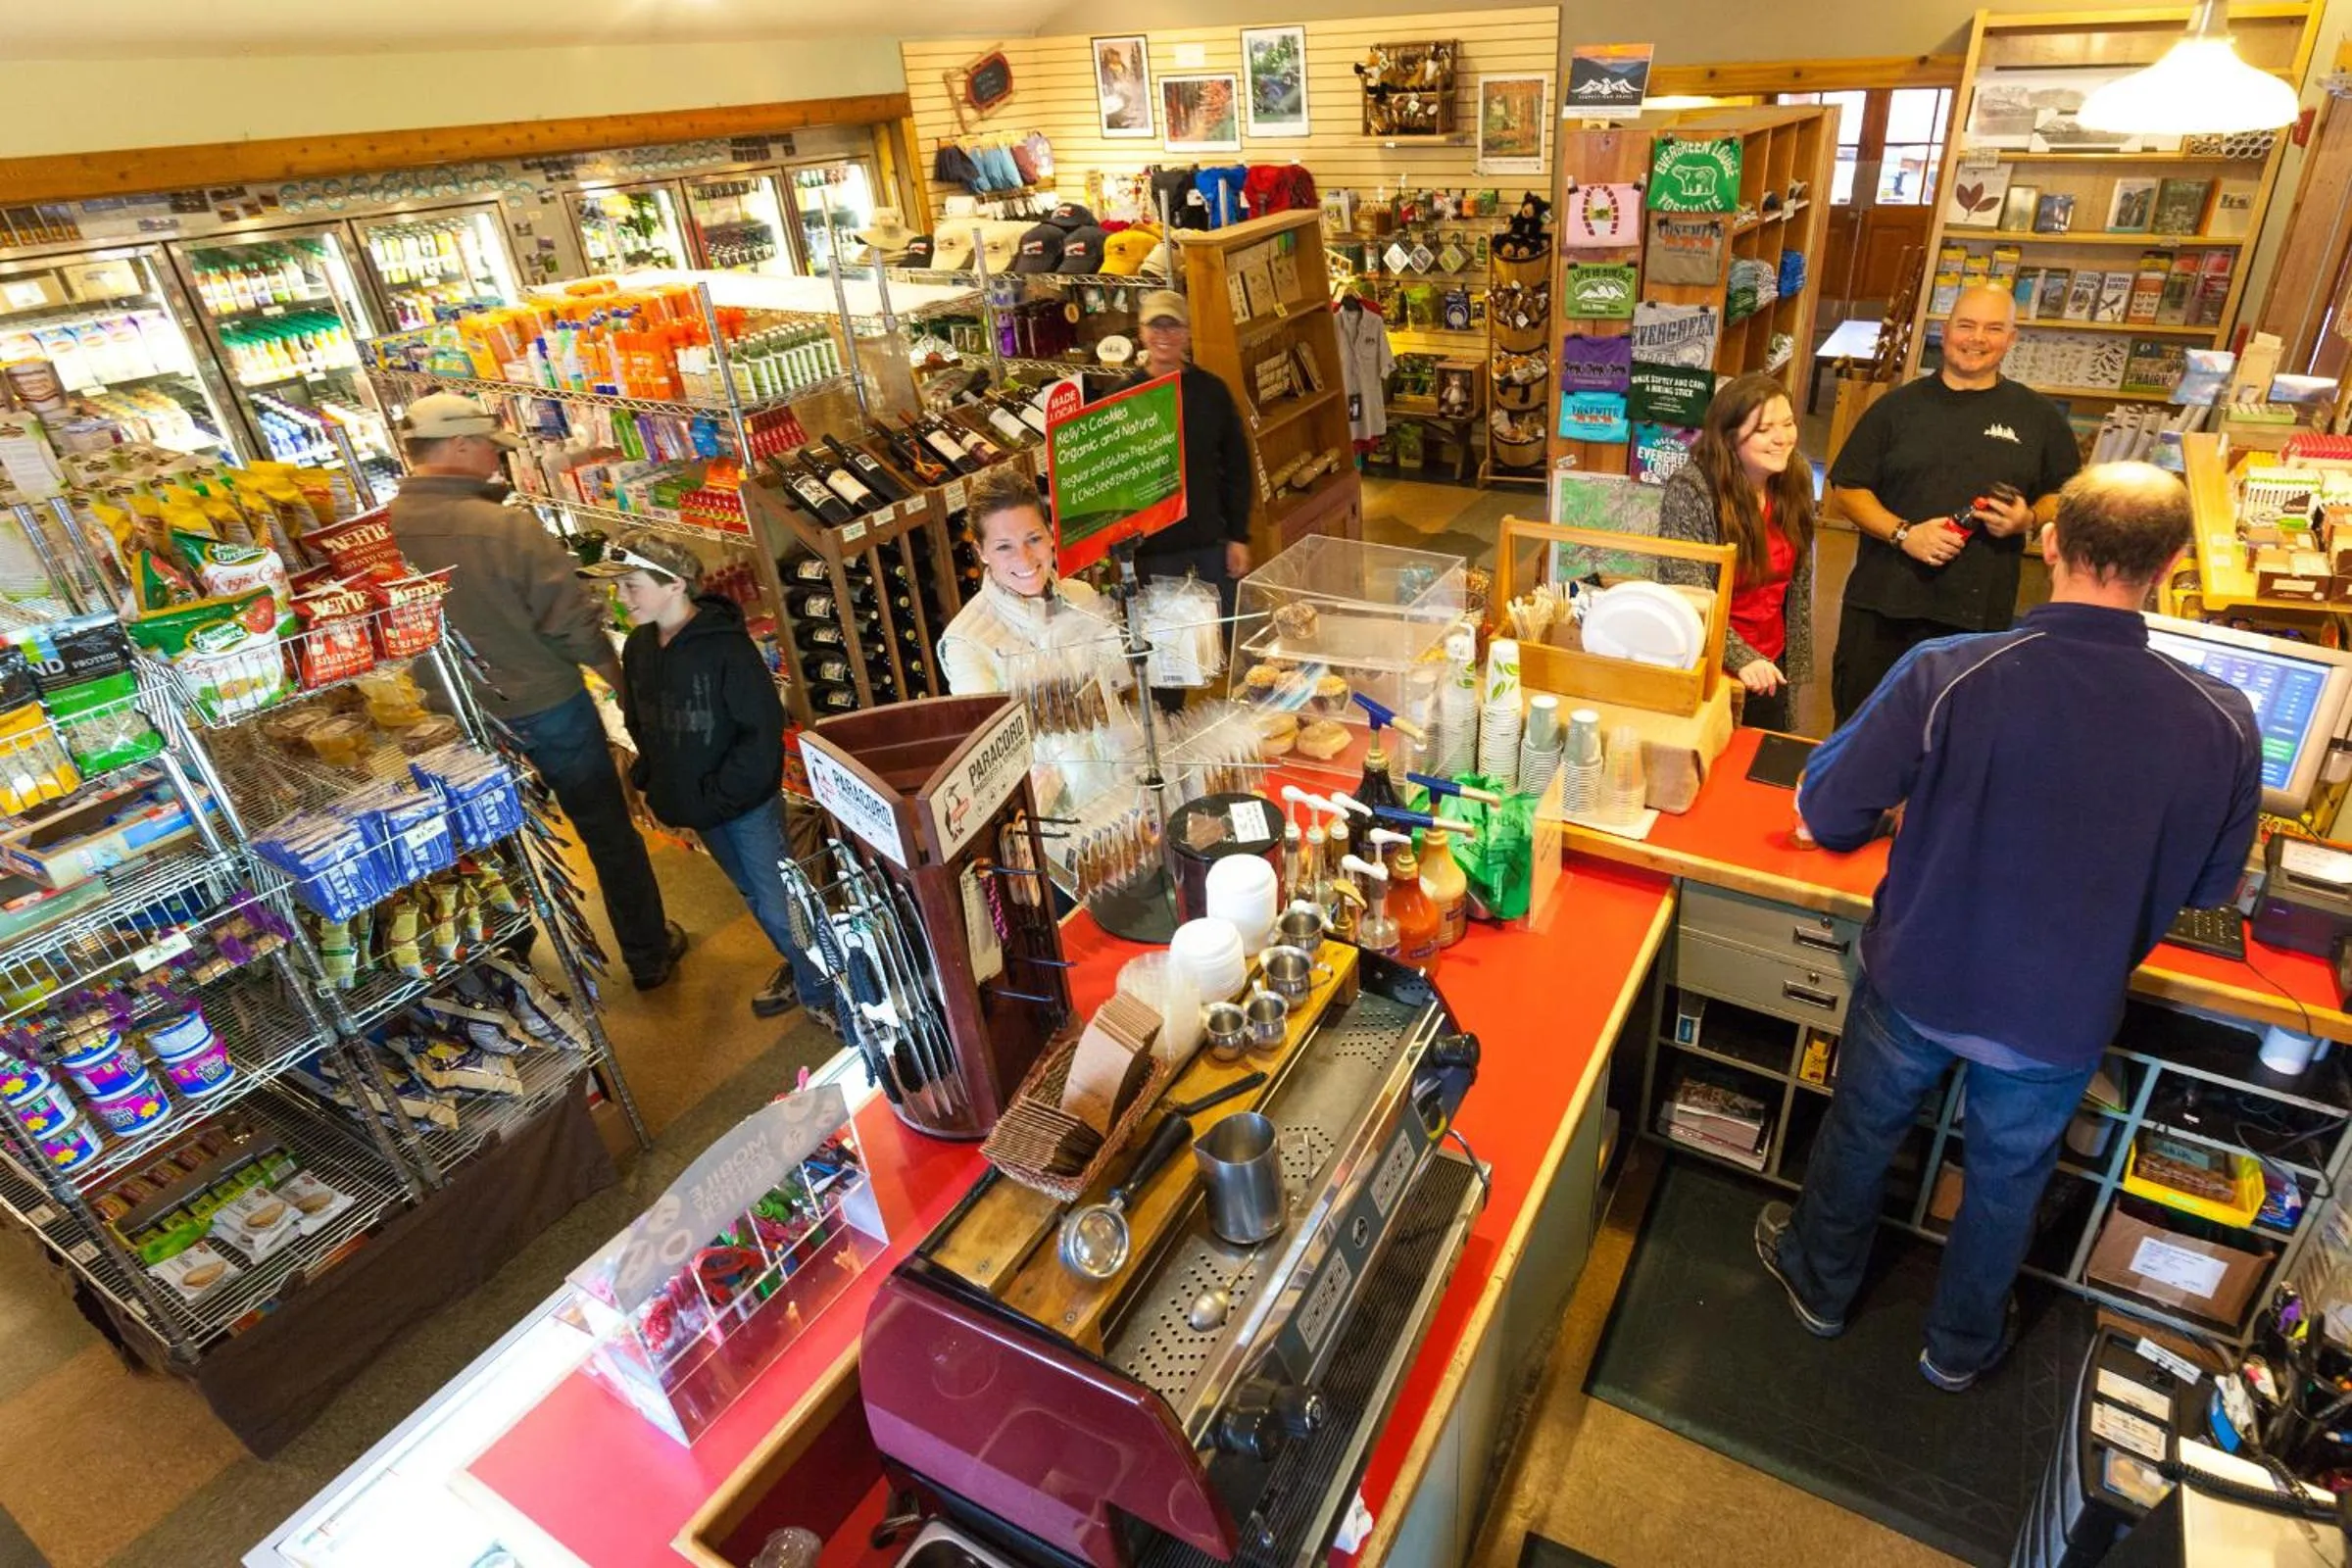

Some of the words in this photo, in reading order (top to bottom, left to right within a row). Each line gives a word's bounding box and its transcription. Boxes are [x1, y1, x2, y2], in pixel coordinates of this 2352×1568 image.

[1654, 140, 1712, 175] EVERGREEN
[1657, 191, 1724, 213] YOSEMITE
[1051, 391, 1077, 410] MADE
[1055, 422, 1088, 448] Kelly's
[1089, 407, 1129, 432] Cookies
[1057, 438, 1100, 466] Organic
[1100, 429, 1121, 448] and
[1121, 412, 1159, 437] Natural
[1060, 469, 1090, 490] Regular
[1090, 462, 1105, 477] and
[1104, 452, 1130, 469] Gluten
[1130, 444, 1148, 457] Free
[1095, 475, 1115, 494] Seed
[1115, 466, 1140, 485] Energy
[968, 714, 1025, 787] PARACORD
[832, 768, 892, 828] PARACORD
